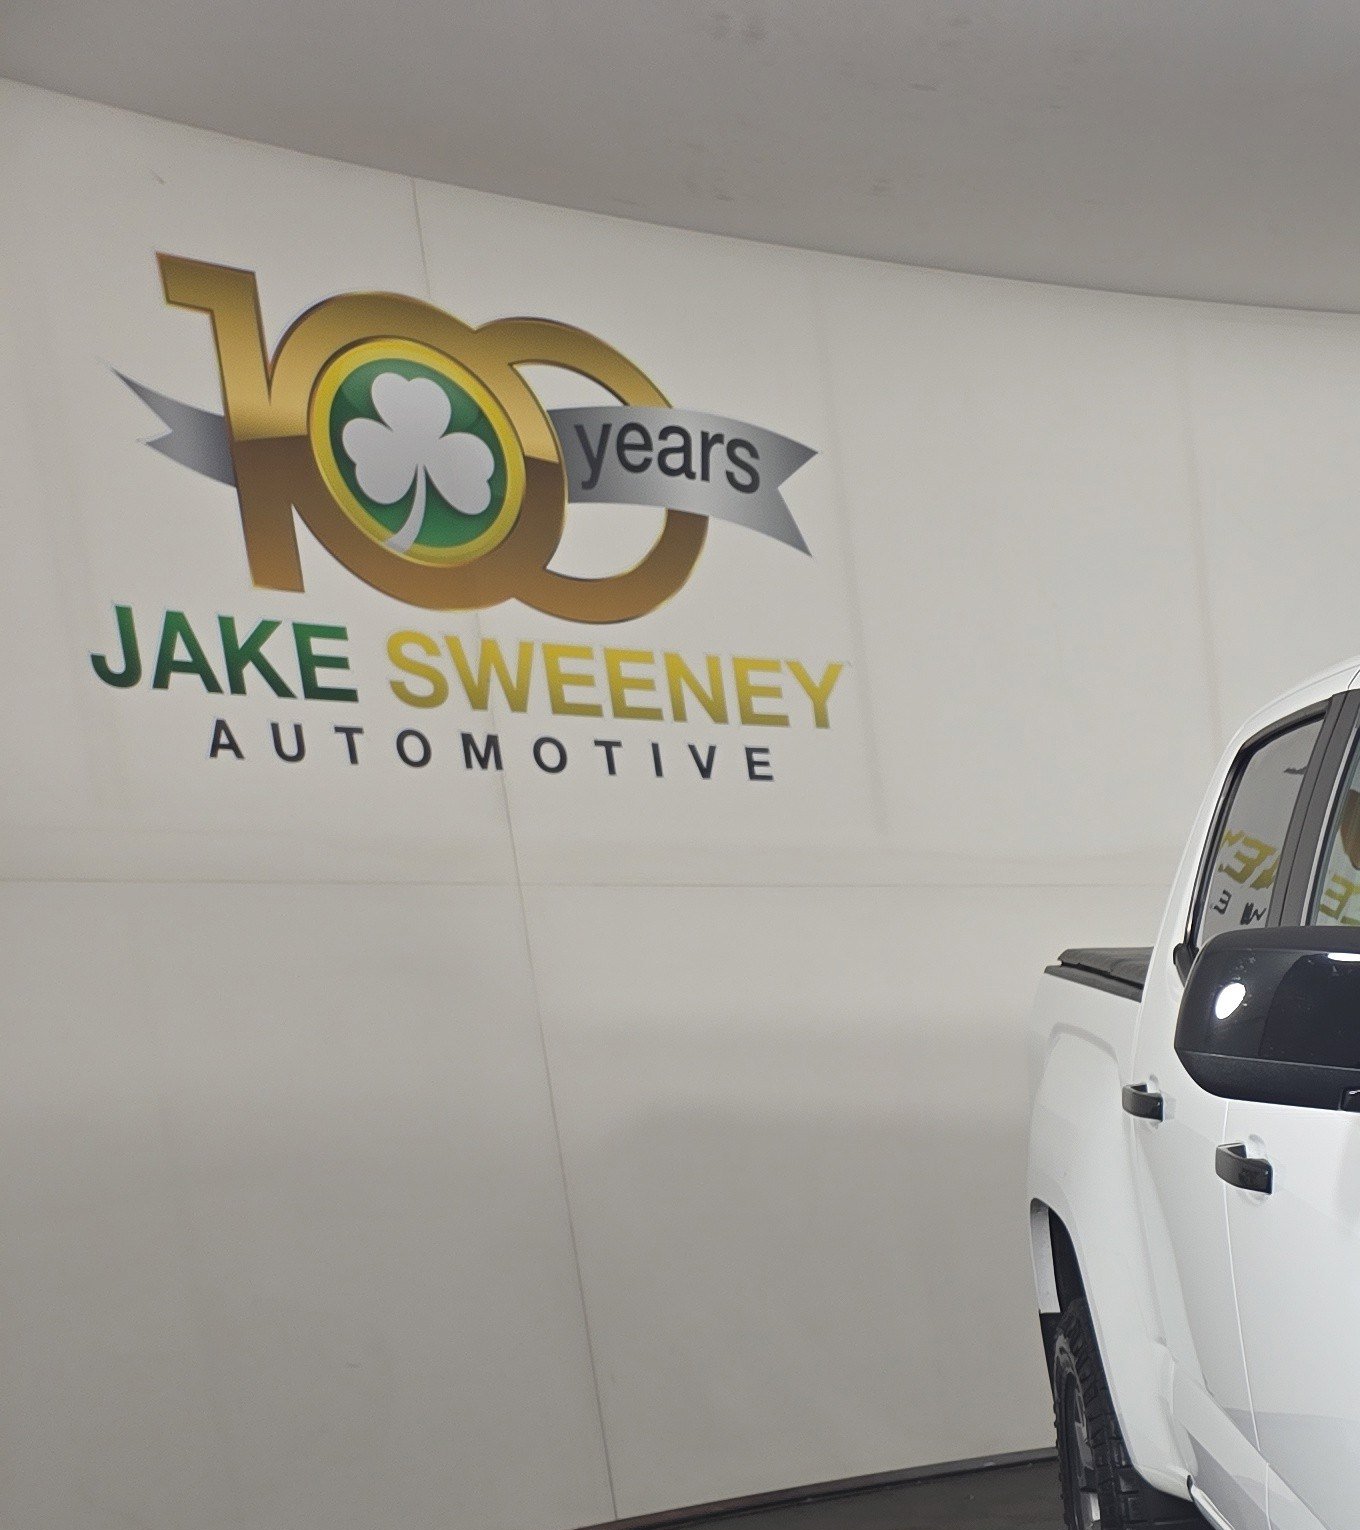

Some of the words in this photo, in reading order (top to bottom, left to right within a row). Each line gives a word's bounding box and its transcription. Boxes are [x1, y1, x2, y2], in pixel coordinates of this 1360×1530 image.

[156, 252, 708, 623] 100
[574, 422, 761, 493] years
[90, 605, 359, 703] JAKE
[386, 632, 843, 729] SWEENEY
[209, 719, 774, 781] AUTOMOTIVE
